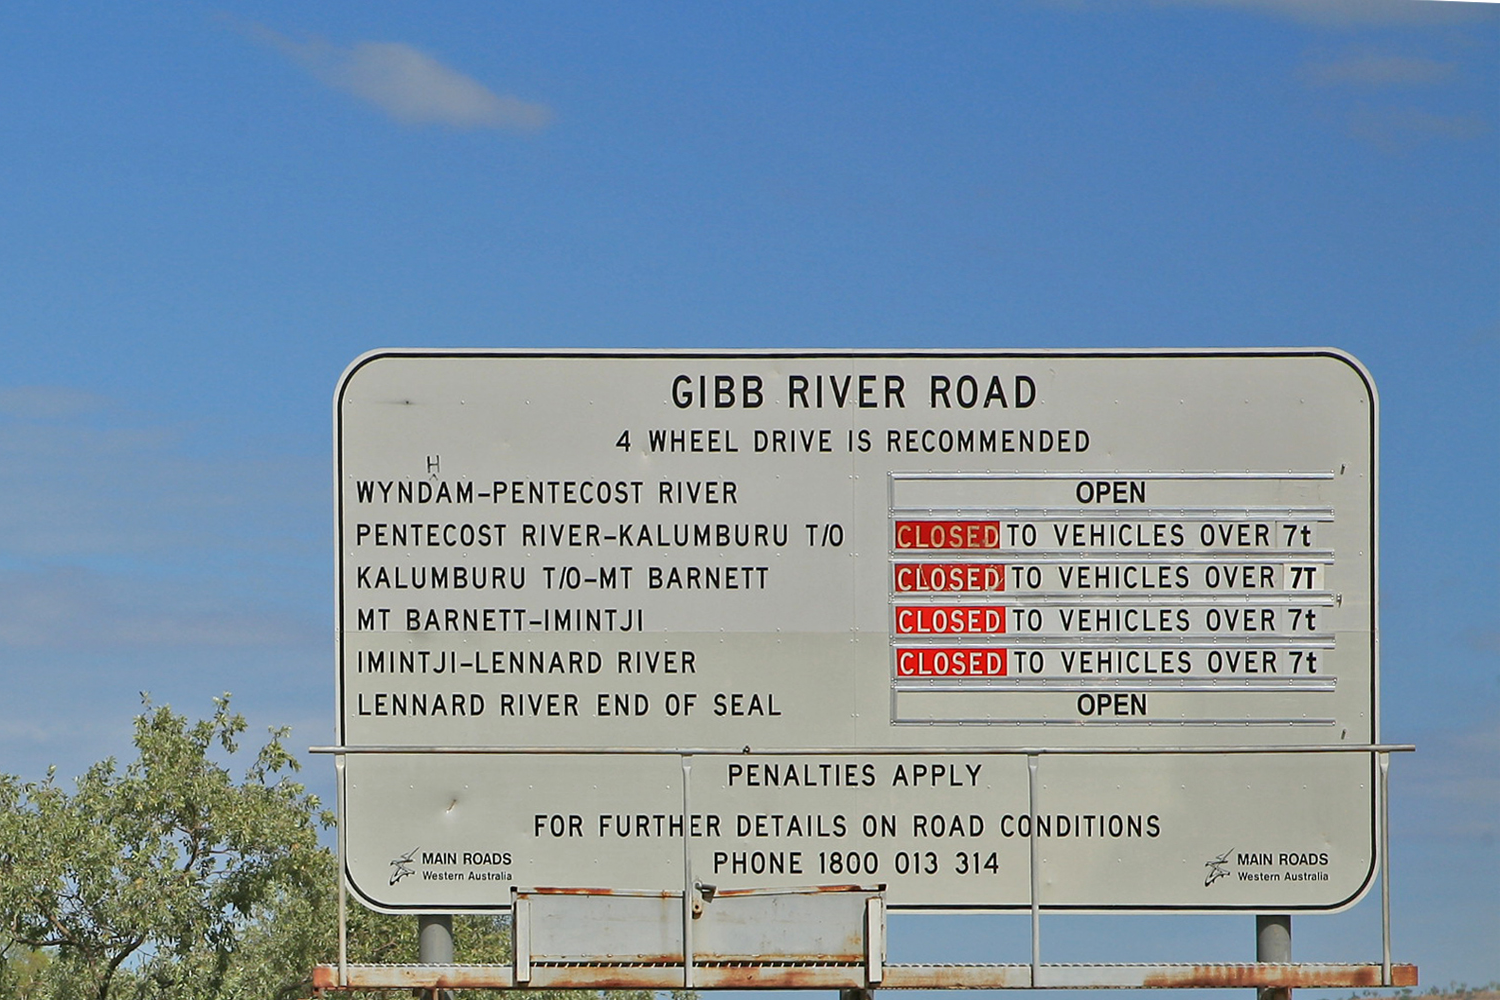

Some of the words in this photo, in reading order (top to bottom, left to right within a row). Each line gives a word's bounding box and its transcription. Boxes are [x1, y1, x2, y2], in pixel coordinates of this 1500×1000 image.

[671, 374, 764, 409] GIBB
[788, 374, 906, 409] RIVER
[930, 374, 1036, 409] ROAD
[615, 429, 631, 453] 4
[648, 429, 739, 453] WHEEL
[754, 429, 833, 453] DRIVE
[848, 429, 872, 453] IS
[887, 429, 1090, 453] RECOMMENDED
[659, 481, 738, 504] RIVER
[1076, 481, 1146, 504] OPEN
[356, 523, 507, 547] PENTECOST
[805, 523, 844, 547] T/O
[896, 524, 999, 547] CLOSED
[1006, 523, 1037, 547] TO
[1053, 523, 1184, 547] VEHICLES
[1200, 523, 1270, 547] OVER
[1282, 524, 1311, 548] 7t
[357, 566, 525, 590] KALUMBURU
[648, 566, 769, 590] BARNETT
[897, 567, 1002, 590] CLOSED
[1011, 566, 1042, 590] TO
[1058, 565, 1189, 589] VEHICLES
[1205, 565, 1275, 589] OVER
[1290, 566, 1317, 590] 7T
[358, 608, 391, 631] MT
[898, 610, 1001, 632] CLOSED
[1012, 608, 1043, 632] TO
[1058, 608, 1190, 632] VEHICLES
[1206, 608, 1276, 632] OVER
[1287, 608, 1316, 631] 7t
[618, 651, 696, 674] RIVER
[899, 652, 1002, 675] CLOSED
[1013, 650, 1044, 674] TO
[1060, 650, 1192, 674] VEHICLES
[1207, 650, 1277, 674] OVER
[1288, 651, 1317, 674] 7t
[358, 693, 485, 717] LENNARD
[500, 693, 579, 717] RIVER
[597, 693, 649, 717] END
[665, 693, 697, 717] OF
[713, 693, 782, 717] SEAL
[1077, 693, 1147, 716] OPEN
[728, 763, 876, 787] PENALTIES
[892, 764, 982, 787] APPLY
[534, 814, 583, 838] FOR
[599, 814, 721, 838] FURTHER
[737, 814, 847, 838] DETAILS
[862, 814, 896, 838] ON
[913, 814, 984, 838] ROAD
[1000, 815, 1161, 838] CONDITIONS
[422, 852, 457, 865] MAIN
[463, 852, 512, 866] ROADS
[714, 851, 803, 875] PHONE
[819, 851, 879, 875] 1800
[894, 851, 938, 875] 013
[955, 851, 999, 875] 314
[1237, 853, 1273, 866] MAIN
[1279, 852, 1329, 866] ROADS
[422, 870, 464, 881] Western
[467, 871, 513, 881] Australia
[1237, 871, 1281, 882] Western
[1284, 871, 1329, 882] Australia
